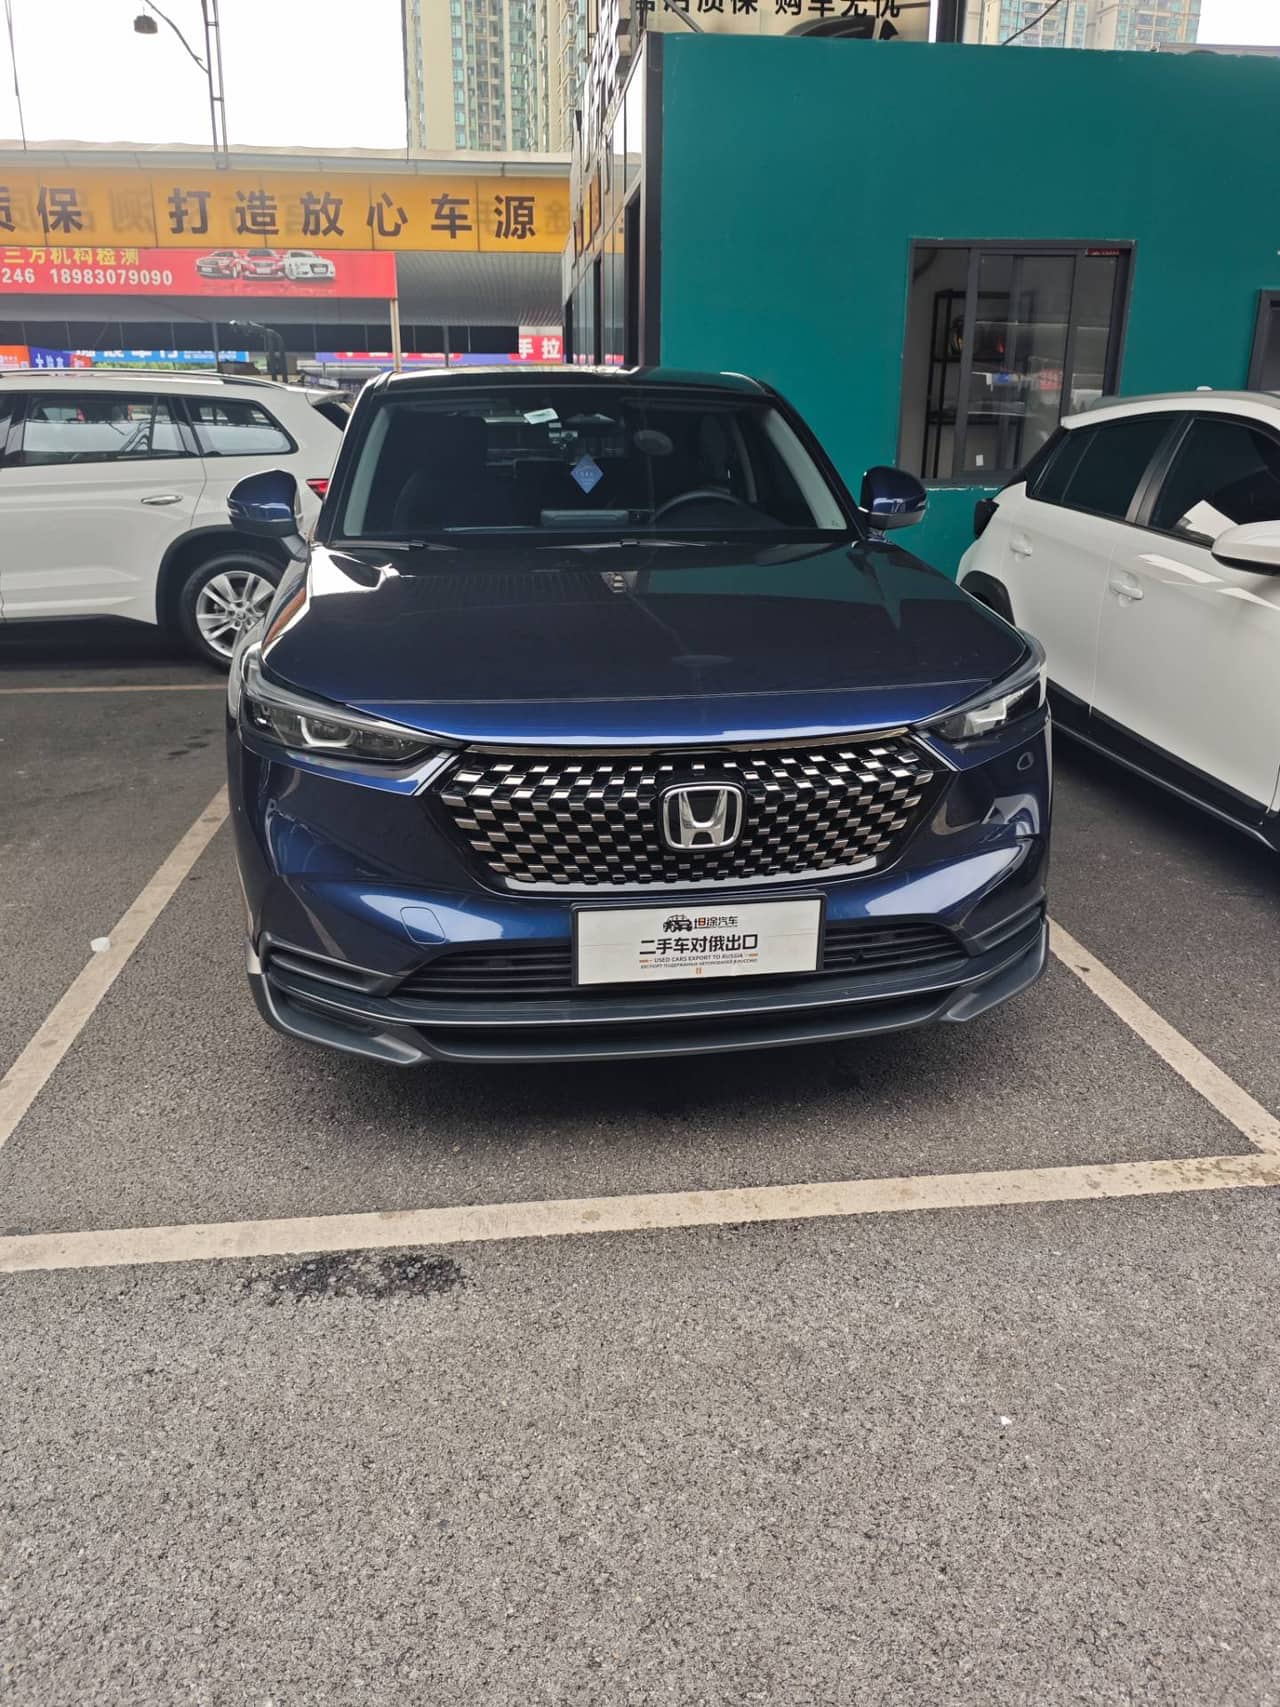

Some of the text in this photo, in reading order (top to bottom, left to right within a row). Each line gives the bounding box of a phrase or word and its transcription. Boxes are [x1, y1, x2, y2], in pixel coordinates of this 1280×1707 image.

[168, 187, 536, 240] 打造放心车源
[1, 268, 173, 286] 246 18983079090
[639, 934, 758, 955] 二手车对俄出口
[688, 954, 711, 962] EXPORT
